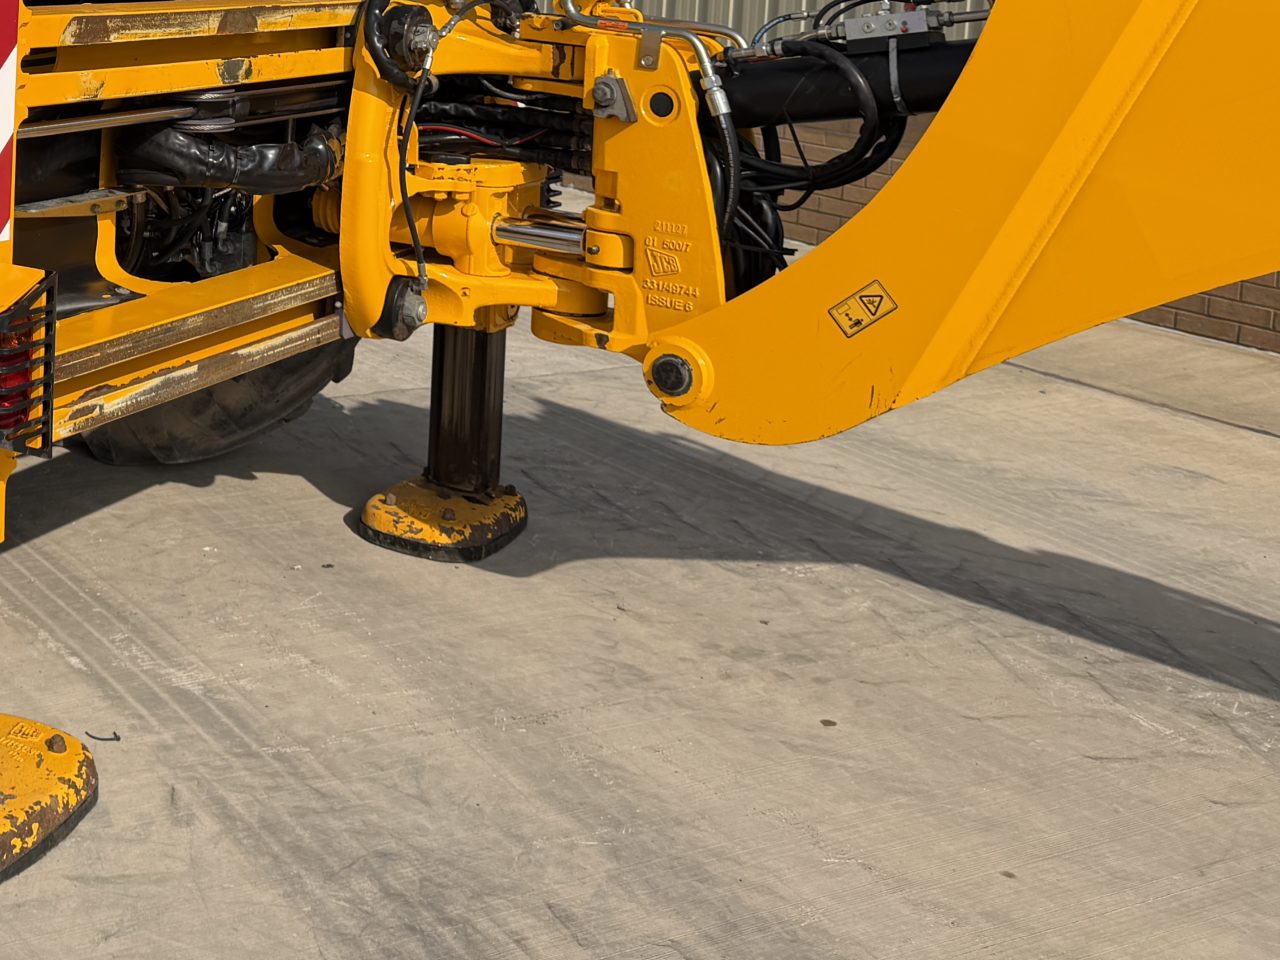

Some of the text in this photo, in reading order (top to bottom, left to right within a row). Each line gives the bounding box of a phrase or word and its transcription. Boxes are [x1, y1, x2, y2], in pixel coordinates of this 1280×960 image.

[651, 250, 678, 274] JCB
[646, 293, 694, 312] ISSUE 6
